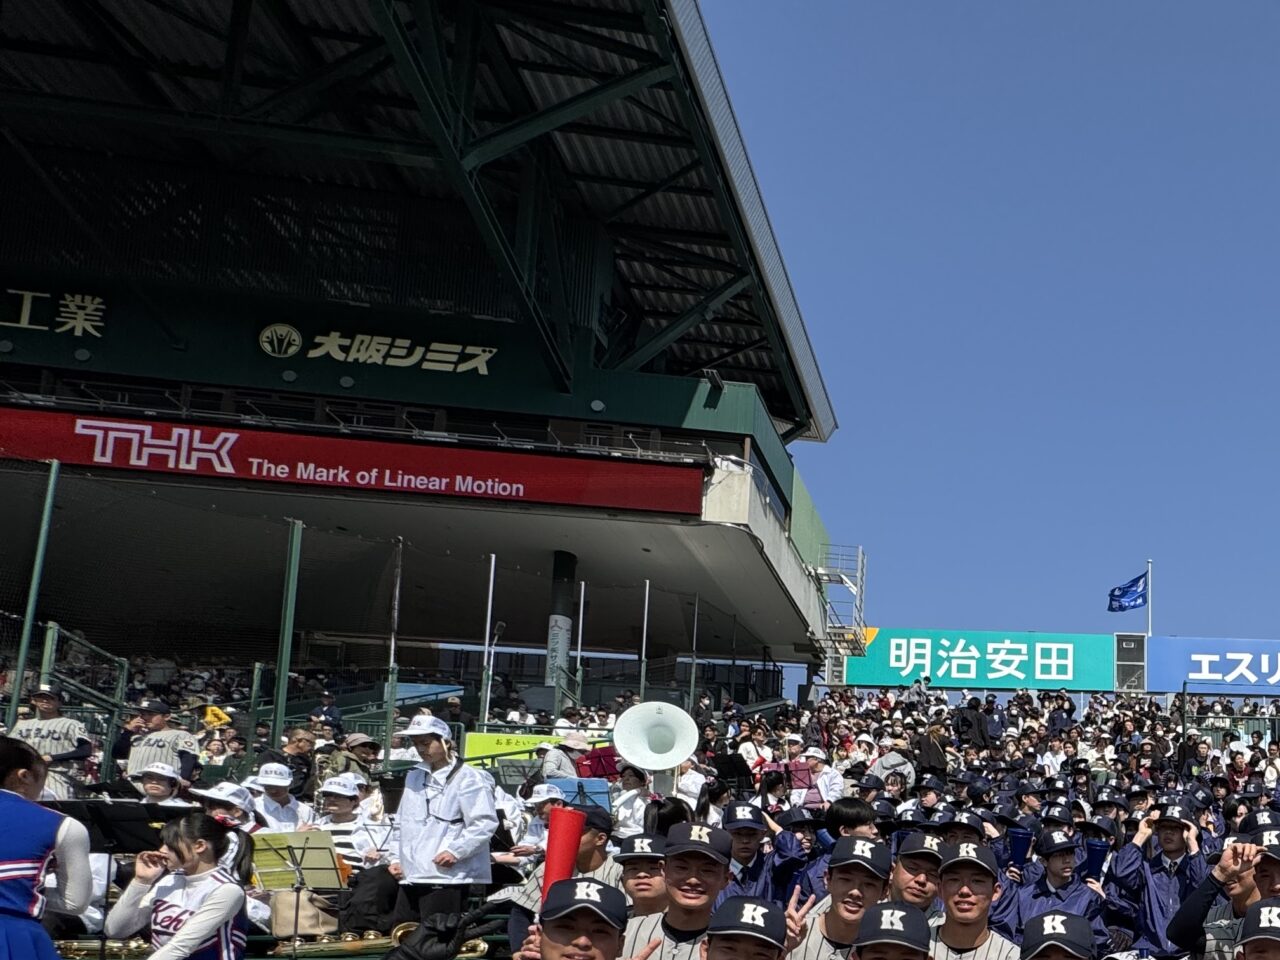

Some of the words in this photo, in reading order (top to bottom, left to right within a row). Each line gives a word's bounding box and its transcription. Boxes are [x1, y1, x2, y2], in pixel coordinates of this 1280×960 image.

[0, 289, 106, 337] 工業
[307, 331, 497, 375] 大阪シミズ
[75, 419, 239, 473] THK
[248, 457, 290, 478] The
[296, 462, 350, 483] Mark
[356, 468, 378, 485] of
[384, 469, 449, 491] Linear
[455, 475, 524, 497] Motion
[889, 637, 1074, 681] 明治安田
[736, 806, 752, 819] K
[1256, 812, 1271, 824] K
[690, 826, 712, 843] K
[924, 836, 940, 851] K
[1263, 831, 1279, 845] K
[634, 839, 652, 852] K
[854, 839, 875, 859] K
[959, 842, 977, 858] K
[575, 882, 603, 902] K
[740, 904, 769, 927] K
[881, 910, 906, 930] K
[1044, 915, 1067, 934] K
